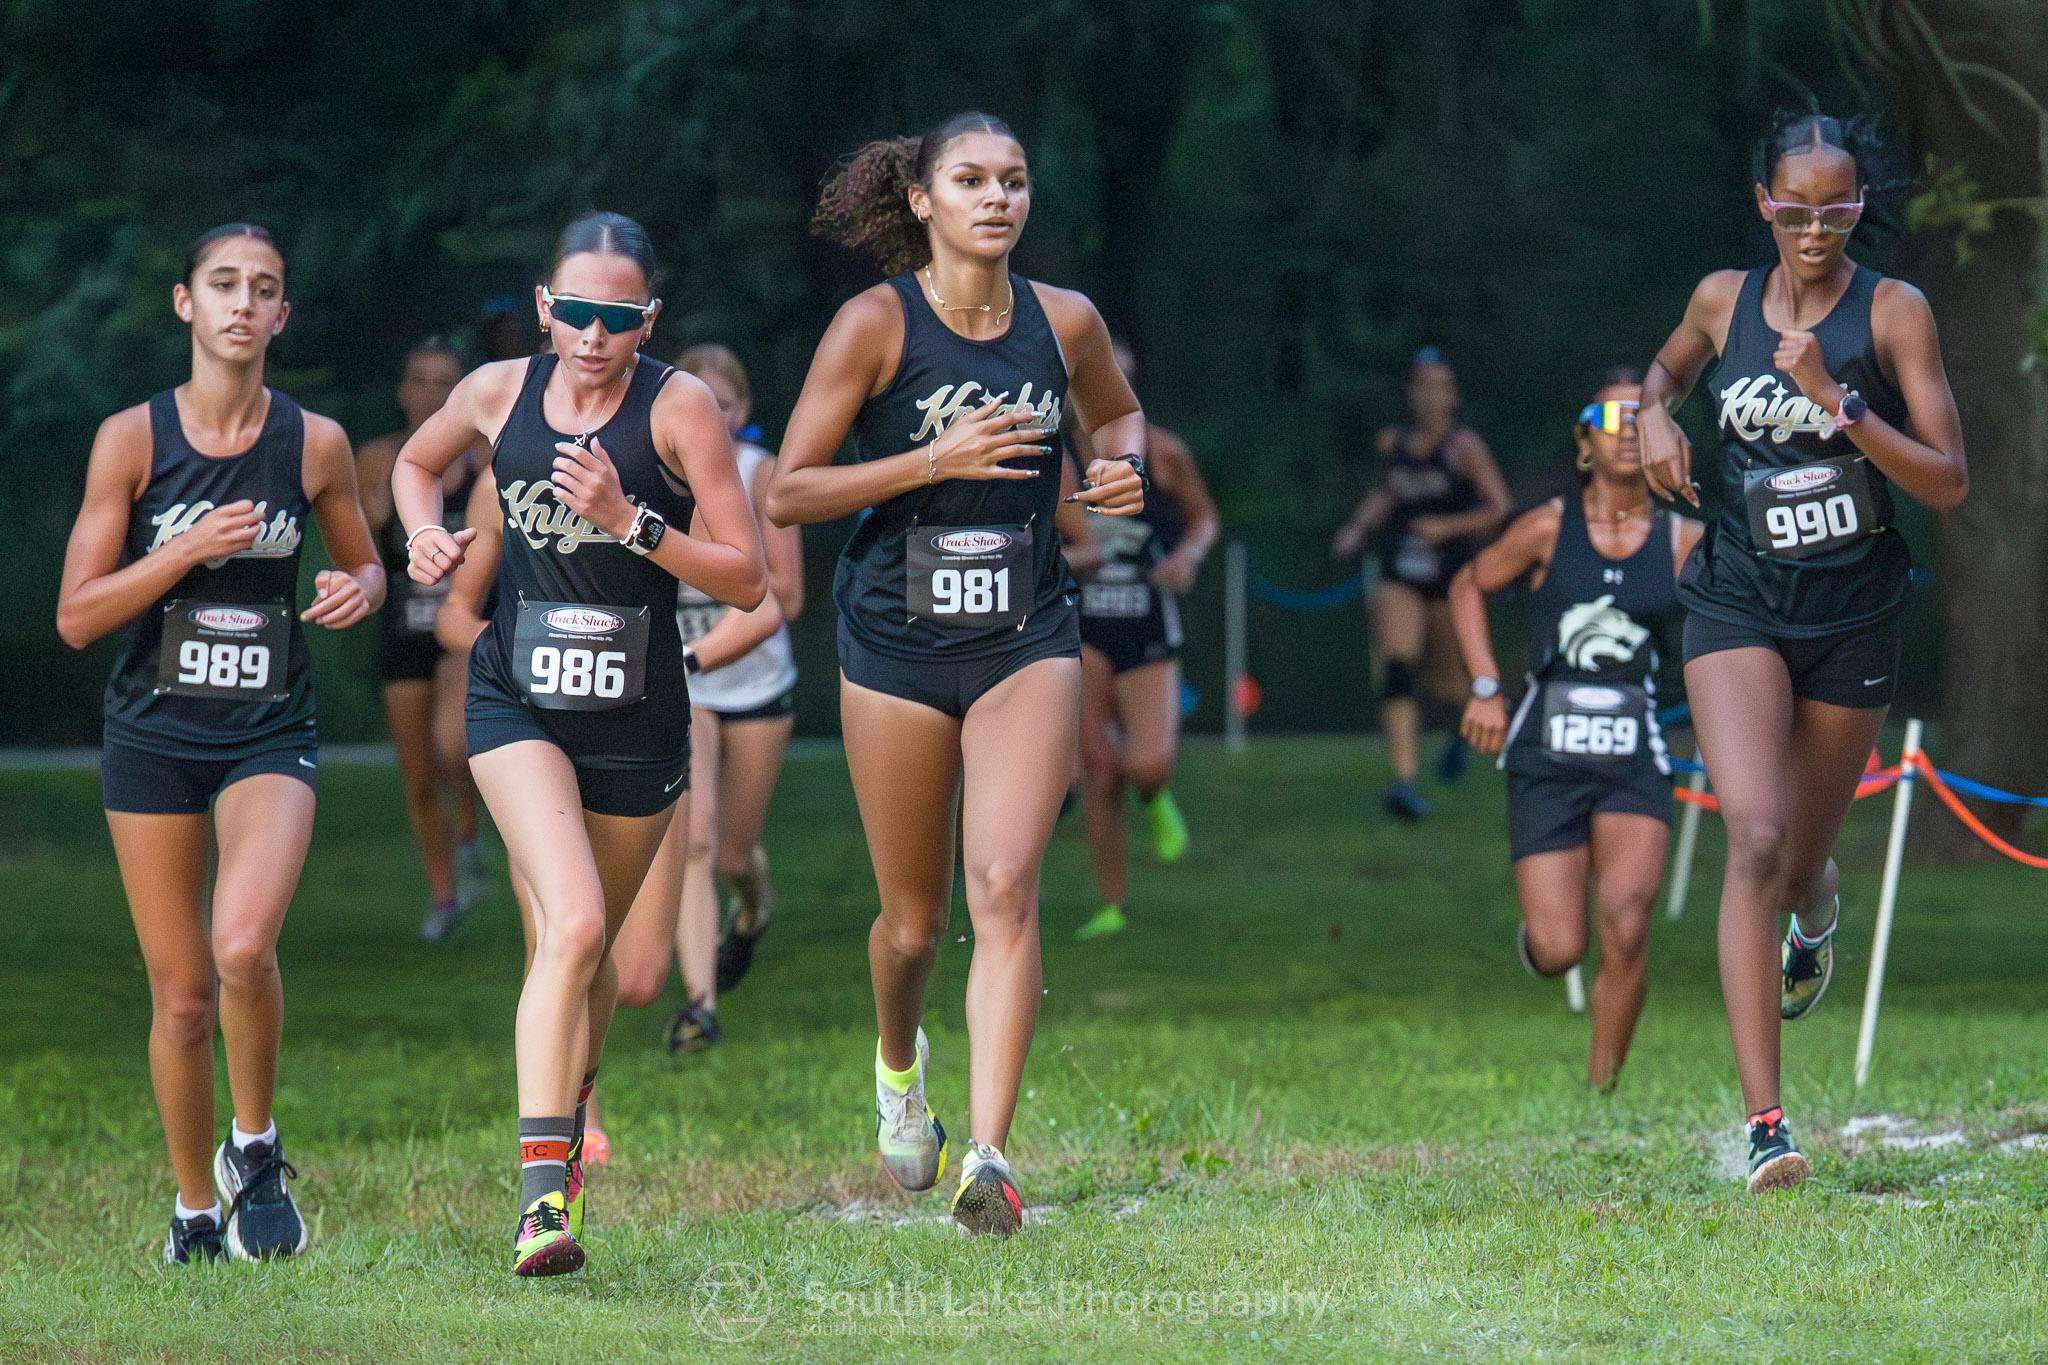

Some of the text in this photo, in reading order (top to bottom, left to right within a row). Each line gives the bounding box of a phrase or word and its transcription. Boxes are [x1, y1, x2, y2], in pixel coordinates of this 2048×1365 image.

[1719, 374, 1859, 444] Knigh
[501, 480, 636, 554] Knig
[938, 533, 1008, 548] Track Shack
[1766, 493, 1858, 549] 990
[932, 567, 1009, 614] 981
[547, 612, 620, 629] Track Shack
[178, 640, 270, 689] 989
[530, 646, 626, 699] 986
[1550, 714, 1638, 755] 1269
[521, 1144, 548, 1158] TC
